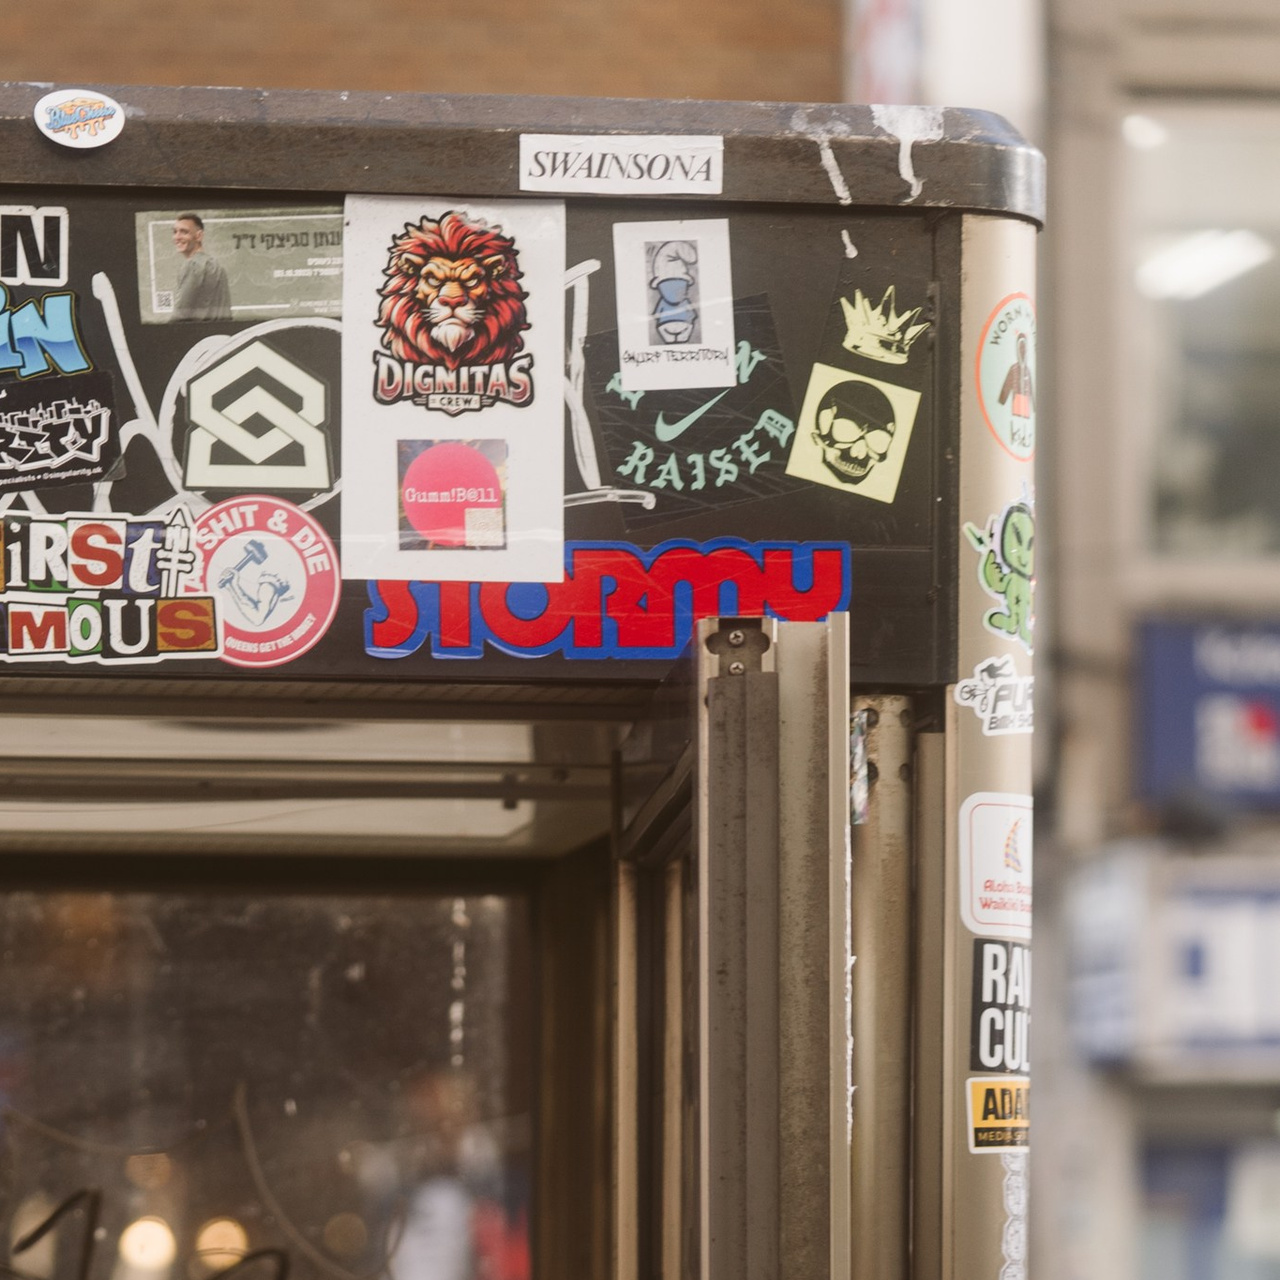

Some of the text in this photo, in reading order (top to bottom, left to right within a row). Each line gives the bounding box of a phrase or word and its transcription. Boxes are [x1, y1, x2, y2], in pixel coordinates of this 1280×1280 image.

[528, 148, 713, 183] SWAINSONA
[374, 352, 534, 403] DIGNITAS
[439, 396, 474, 408] CREW
[616, 409, 795, 491] RAISED
[197, 504, 333, 576] SHIT & DIE
